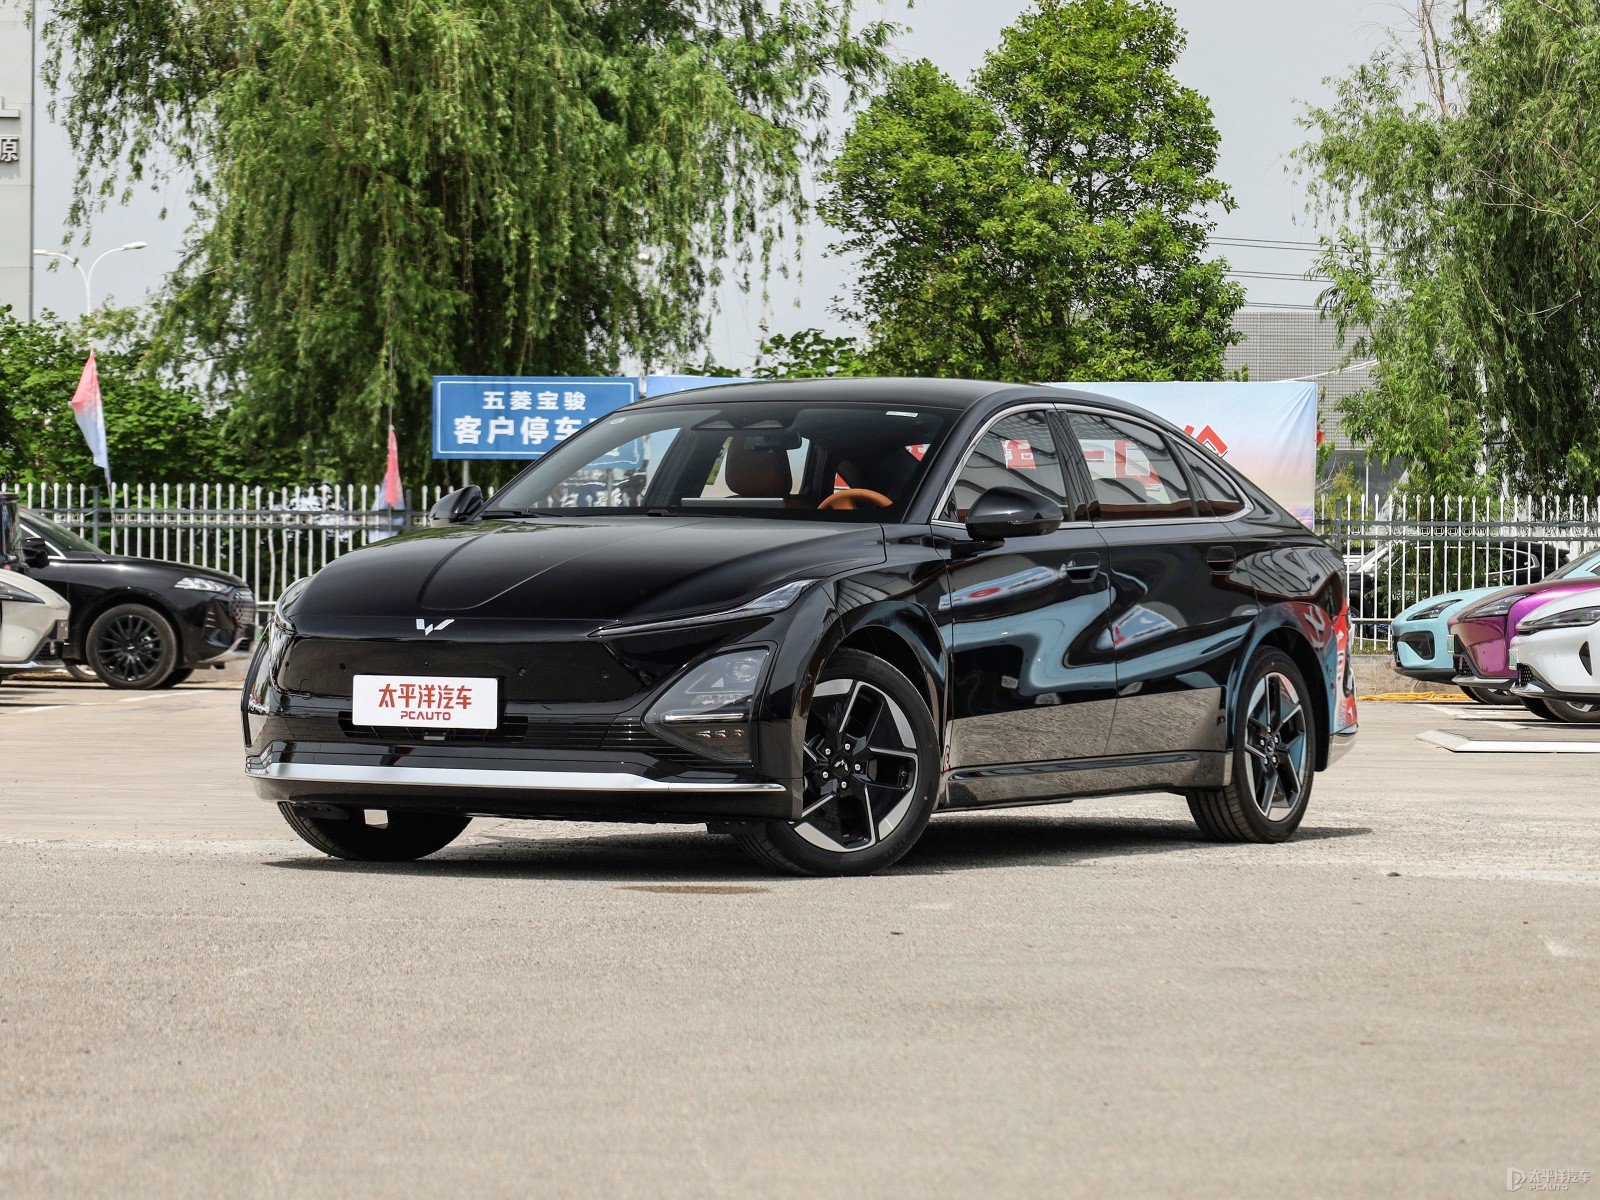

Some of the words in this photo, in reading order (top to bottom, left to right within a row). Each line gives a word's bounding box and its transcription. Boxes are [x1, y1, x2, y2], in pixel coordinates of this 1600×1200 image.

[0, 135, 20, 162] 原
[482, 390, 587, 411] 五菱宝骏
[453, 415, 598, 445] 客户停车
[378, 683, 472, 710] 太平洋汽车
[400, 710, 452, 721] PCAUTO
